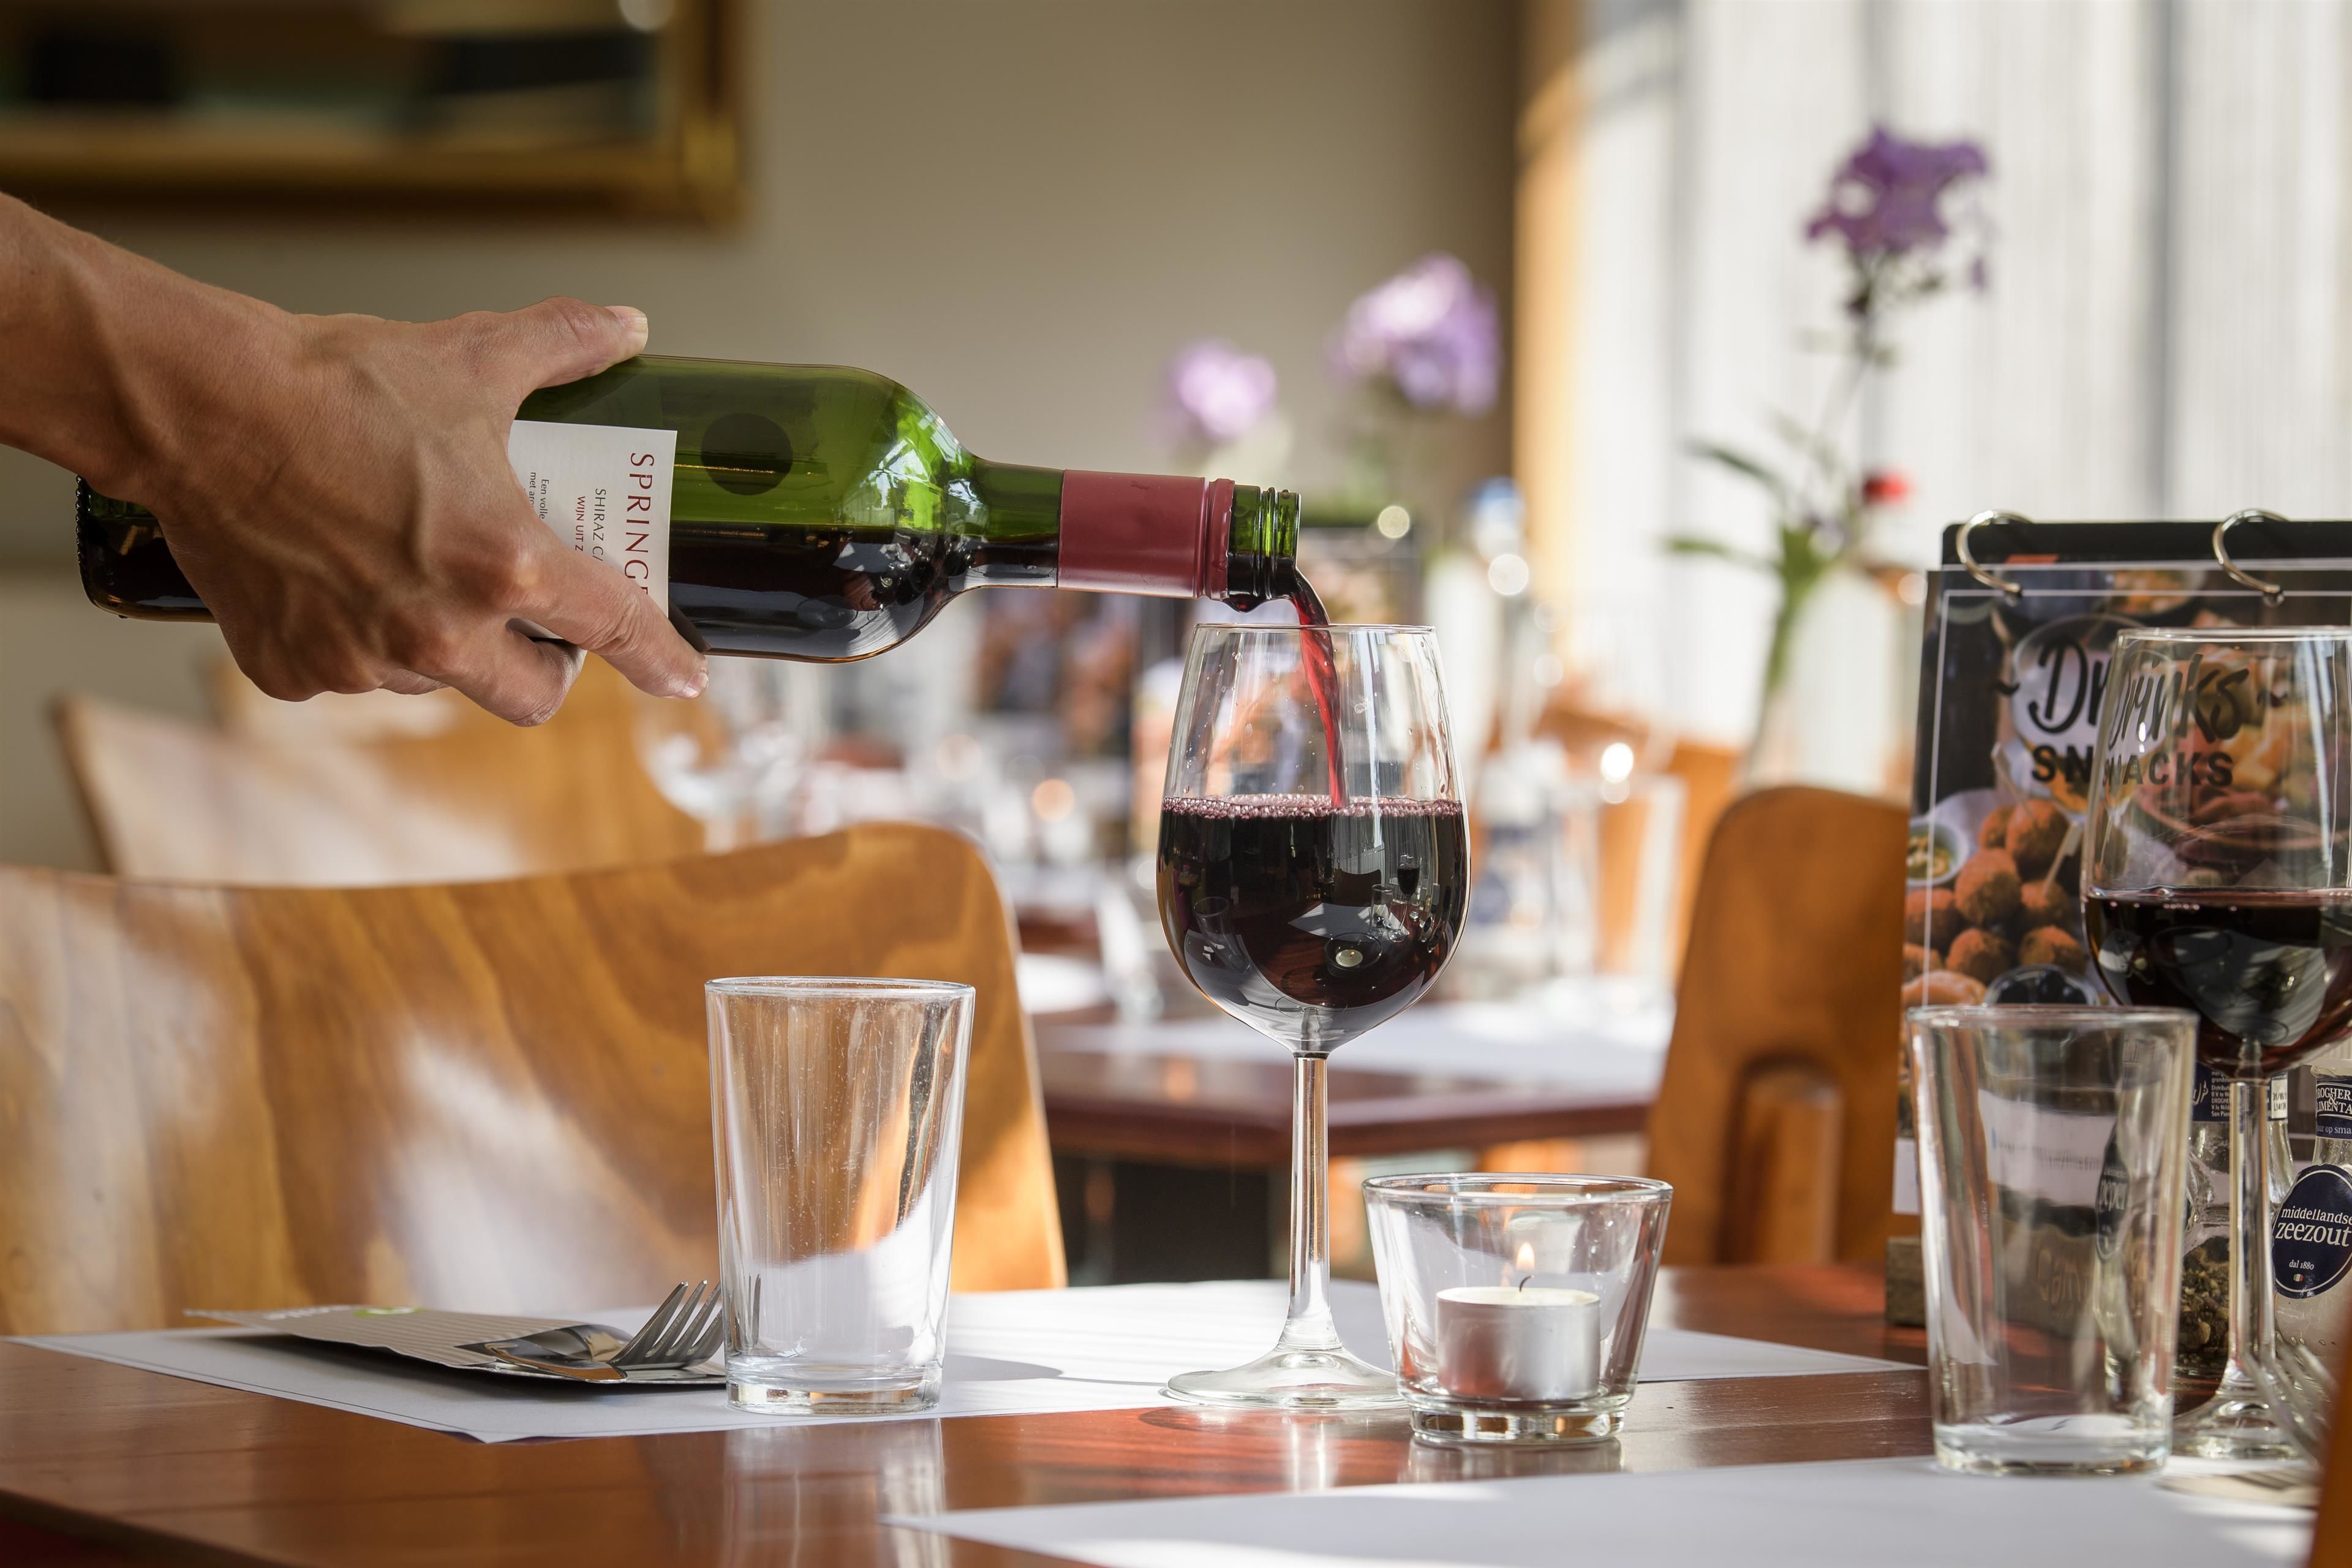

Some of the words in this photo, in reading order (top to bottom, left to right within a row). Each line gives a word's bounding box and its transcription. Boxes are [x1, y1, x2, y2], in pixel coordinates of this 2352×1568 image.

[541, 479, 549, 494] Een
[539, 497, 548, 519] volle
[575, 496, 586, 521] WIJN
[592, 488, 606, 541] SHIRAZ
[624, 452, 655, 595] SPRING
[575, 525, 584, 542] UIT
[2032, 745, 2234, 786] SNACKS
[2317, 1087, 2352, 1101] ROGHER
[2329, 1093, 2339, 1106] &
[2316, 1101, 2352, 1115] LIMENTA
[2325, 1126, 2333, 1135] op
[2280, 1205, 2352, 1226] middellandse
[2275, 1222, 2352, 1248] zeezout
[2288, 1259, 2299, 1268] dal
[2300, 1261, 2315, 1270] 1880
